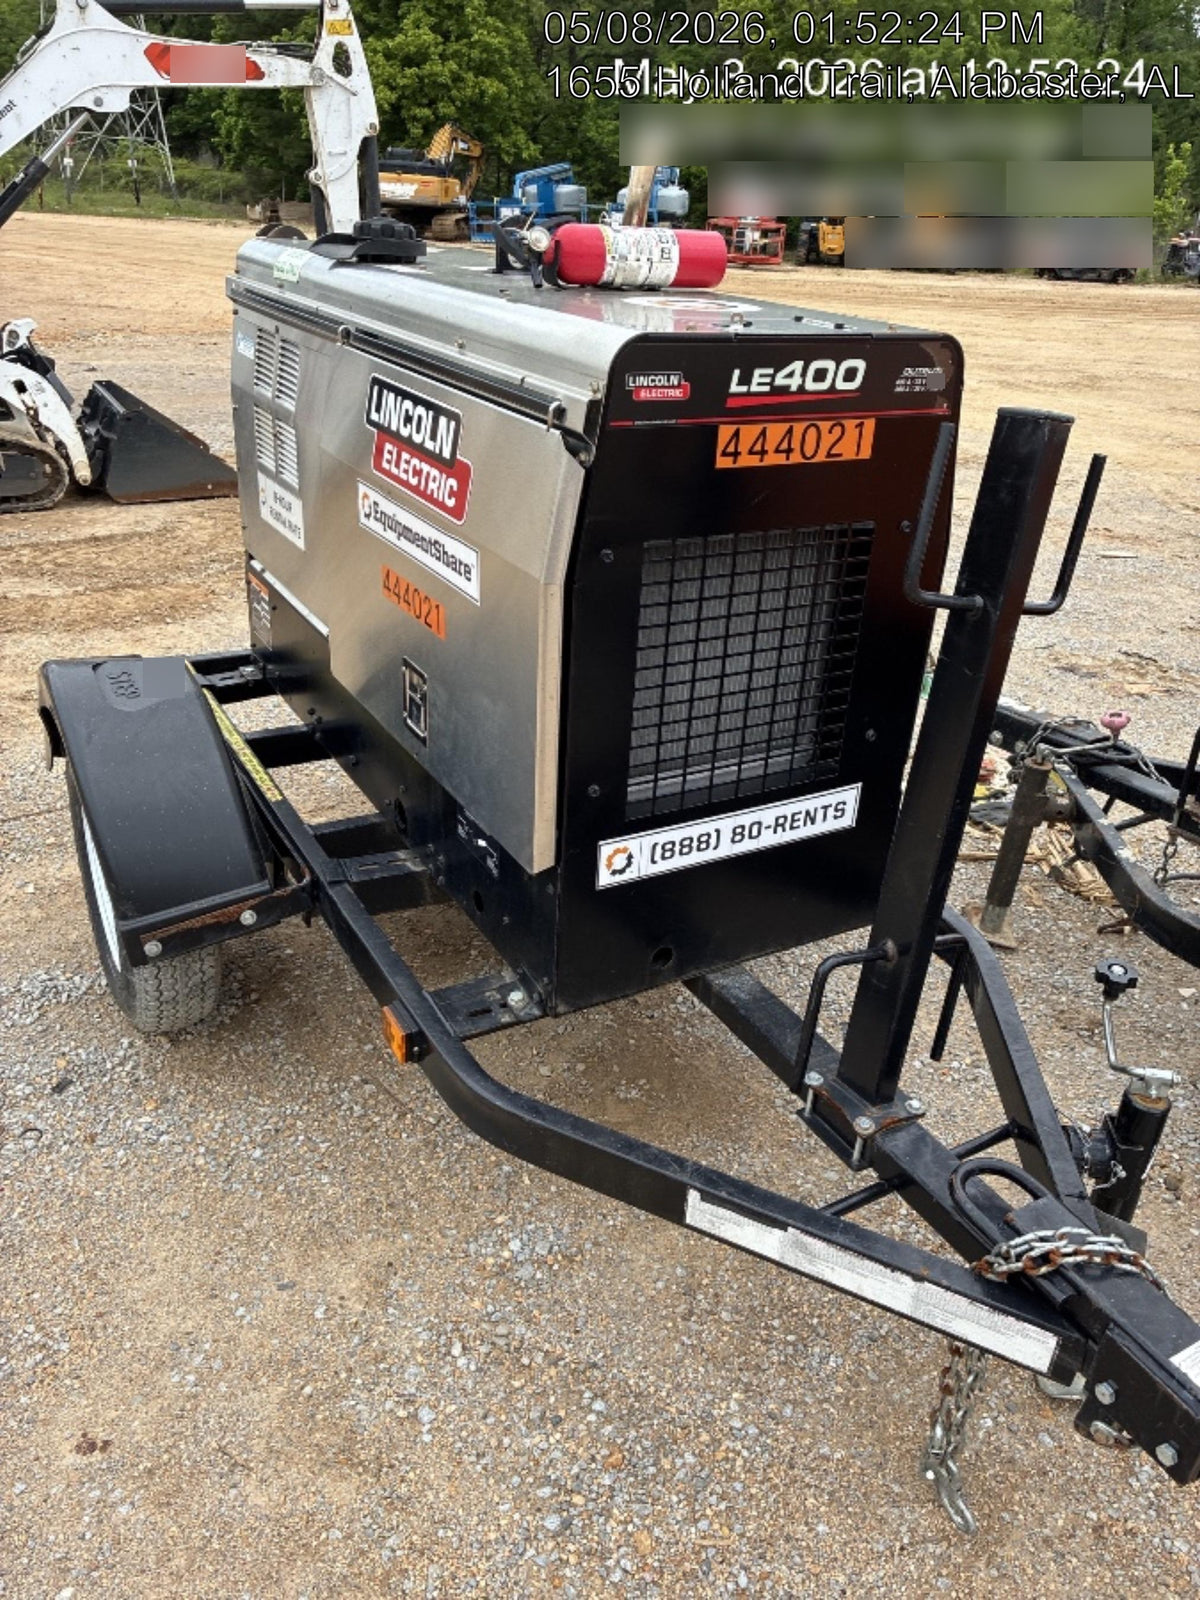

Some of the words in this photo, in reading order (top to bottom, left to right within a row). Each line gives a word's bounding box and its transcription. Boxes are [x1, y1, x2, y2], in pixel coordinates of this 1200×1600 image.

[629, 374, 680, 387] LINCOLN
[640, 388, 684, 398] ELECTRIC
[728, 358, 867, 394] LE400
[370, 385, 456, 460] LINCOLN
[719, 420, 865, 466] 444021
[382, 442, 458, 508] ELECTRIC
[373, 500, 472, 582] EquipmentShare
[383, 569, 440, 635] 444021
[649, 828, 721, 865] (888)
[730, 801, 848, 845] 80-RENTS
